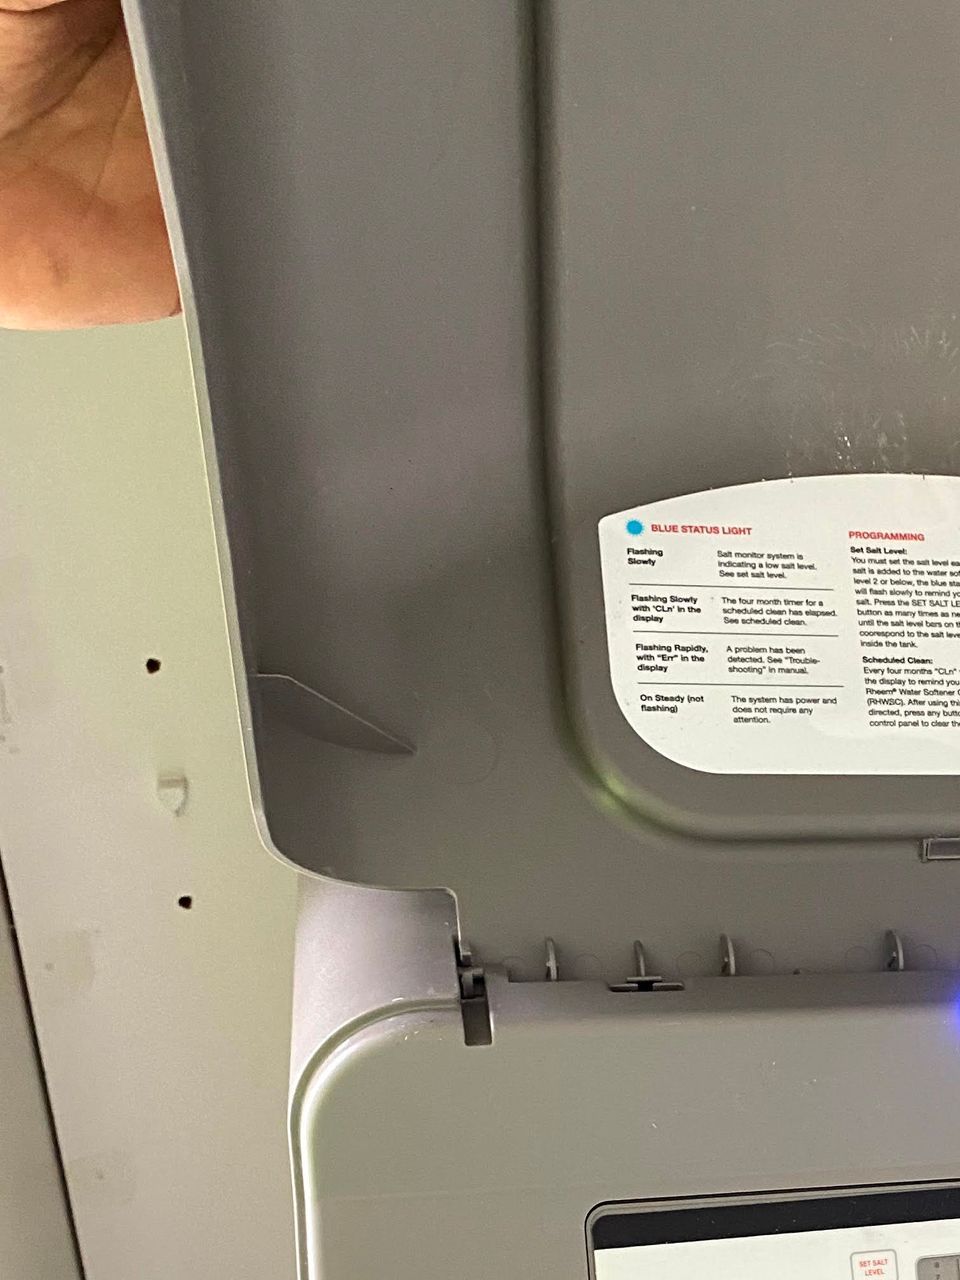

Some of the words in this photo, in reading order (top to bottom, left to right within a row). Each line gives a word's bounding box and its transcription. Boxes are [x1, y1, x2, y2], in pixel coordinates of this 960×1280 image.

[650, 524, 678, 532] BLUE
[680, 525, 719, 534] STATUS
[721, 526, 751, 535] LIGHT
[848, 531, 924, 541] PROGRAMMING
[626, 547, 663, 557] Flashing
[716, 550, 732, 558] Salt
[865, 546, 882, 554] Salt
[627, 557, 656, 566] Slowly
[717, 560, 756, 569] indicating
[764, 561, 779, 569] low
[796, 562, 817, 570] level.
[718, 569, 734, 577] See
[872, 577, 878, 585] 2
[889, 578, 915, 586] below,
[630, 594, 667, 603] Flashing
[669, 595, 697, 604] Slowly
[721, 596, 737, 604] The
[783, 598, 803, 606] timer
[805, 598, 816, 606] for
[873, 598, 895, 606] Press
[911, 598, 926, 606] SET
[928, 599, 948, 607] SALT
[788, 608, 803, 616] has
[804, 609, 837, 617] elapsed.
[632, 614, 663, 623] display
[723, 616, 739, 624] See
[740, 617, 782, 625] scheduled
[635, 643, 672, 652] Flashing
[674, 644, 708, 653] Rapidly,
[768, 646, 783, 654] has
[690, 654, 705, 662] the
[766, 655, 782, 663] See
[907, 656, 933, 664] Clean:
[637, 663, 668, 672] display
[639, 693, 653, 701] On
[654, 694, 684, 703] Steady
[686, 694, 704, 703] (not
[748, 696, 777, 704] system
[640, 704, 678, 713] flashing)
[769, 706, 797, 714] require
[798, 707, 813, 715] any
[872, 1258, 888, 1266] SALT
[864, 1268, 884, 1276] LEVEL
